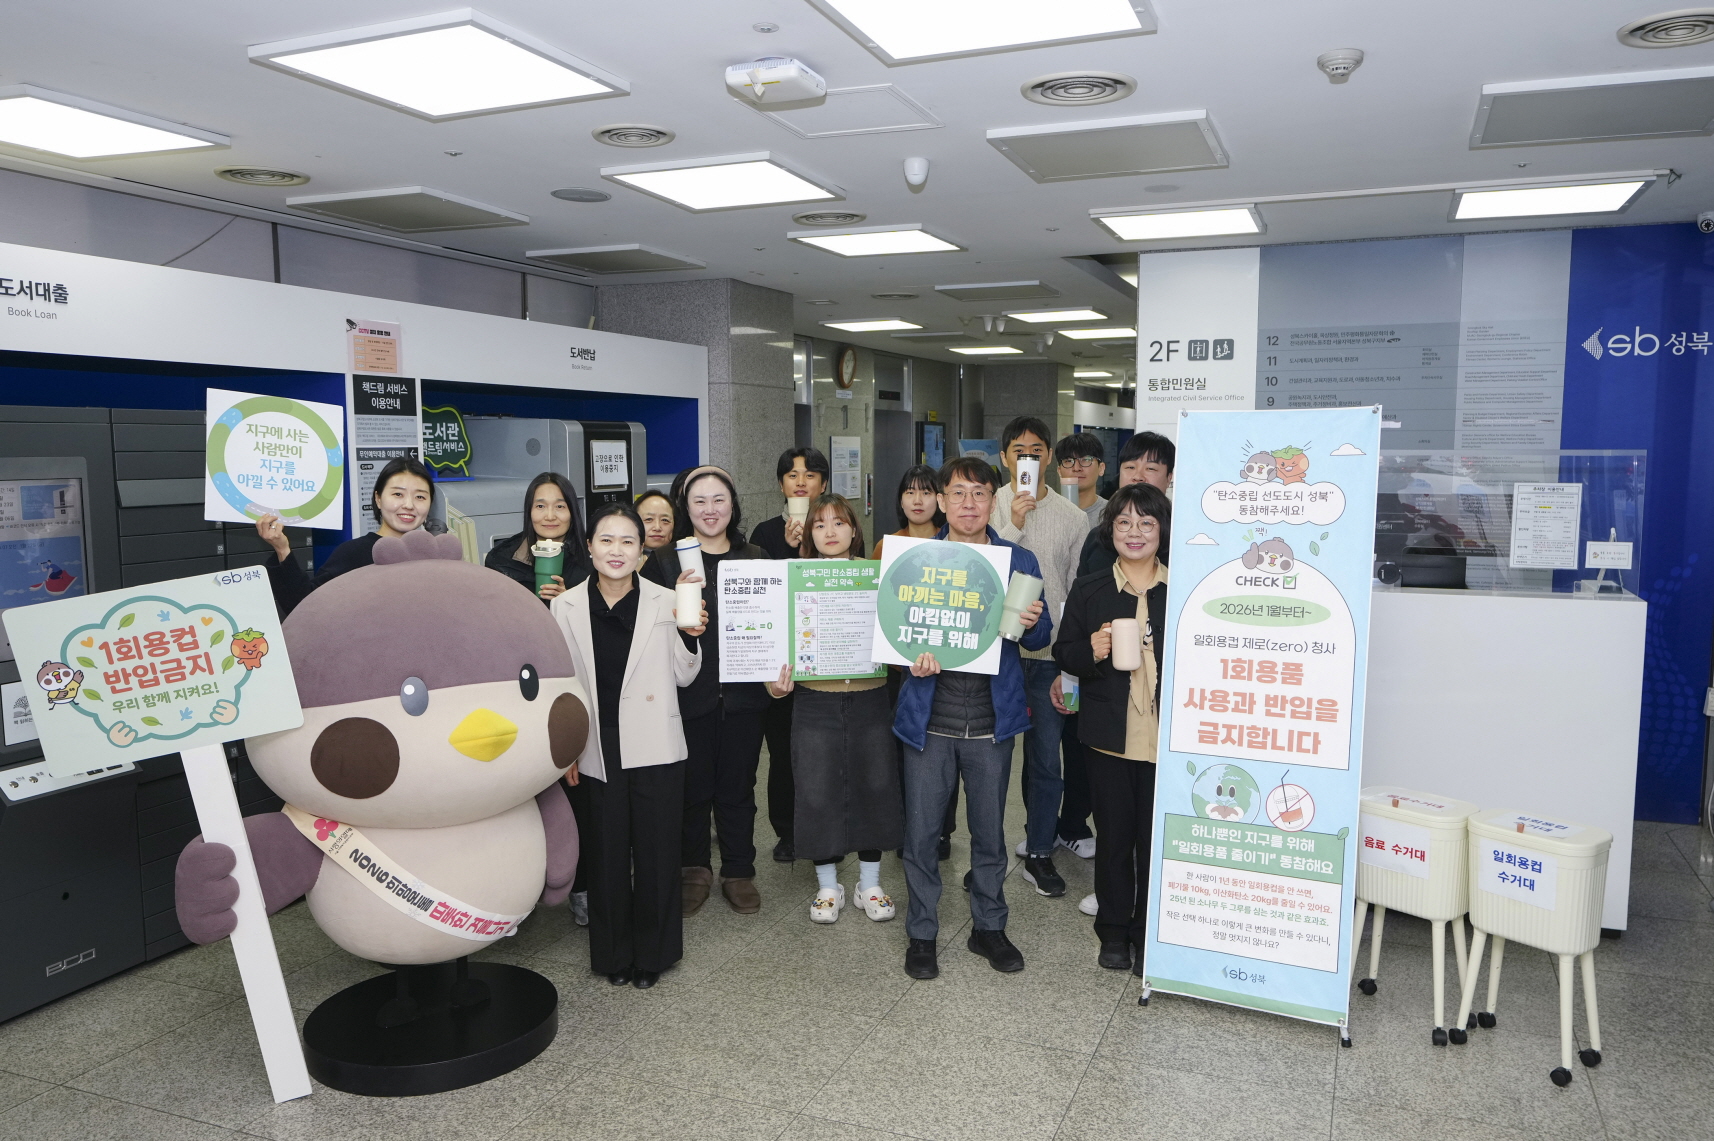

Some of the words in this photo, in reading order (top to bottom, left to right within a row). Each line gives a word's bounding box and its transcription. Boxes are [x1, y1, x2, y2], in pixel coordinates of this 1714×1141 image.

[0, 278, 69, 304] 도서대출
[7, 307, 32, 317] Book
[35, 309, 57, 320] Loan
[1266, 336, 1279, 346] 12
[1608, 326, 1660, 356] sb
[1664, 332, 1713, 356] 성북
[570, 347, 596, 361] 도서반납
[1150, 340, 1180, 362] 2F
[1267, 356, 1277, 366] 11
[362, 382, 385, 394] 책드림
[386, 383, 408, 394] 서비스
[1148, 378, 1206, 392] 통합민원실
[1265, 376, 1278, 386] 10
[371, 397, 401, 409] 이용안내
[1266, 397, 1275, 406] 9
[246, 424, 283, 440] 지구에
[286, 429, 309, 443] 사는
[422, 422, 459, 440] 도서관
[253, 441, 302, 458] 사람만이
[595, 454, 612, 463] 고장으로
[614, 454, 624, 463] 인한
[260, 459, 296, 476] 지구를
[600, 465, 618, 473] 이용중지
[238, 474, 262, 490] 아낄
[266, 476, 278, 490] 수
[282, 478, 316, 492] 있어요
[1213, 490, 1258, 501] "탄소중립
[1262, 490, 1303, 501] 선도도시
[1308, 490, 1334, 503] 성북"
[1239, 505, 1304, 516] 동참해주세요!
[1255, 527, 1267, 536] 짹!
[222, 572, 242, 584] sb
[243, 570, 261, 580] 성북
[802, 568, 830, 577] 성북구민
[832, 568, 859, 577] 탄소중립
[861, 568, 875, 576] 생활
[920, 566, 968, 588] 지구를
[724, 578, 752, 586] 성북구와
[753, 578, 768, 586] 함께
[770, 578, 782, 586] 하는
[724, 587, 751, 595] 탄소중립
[753, 586, 766, 594] 실천
[824, 578, 838, 587] 실천
[840, 578, 854, 586] 약속
[1236, 576, 1279, 588] CHECK
[898, 585, 945, 606] 아끼는
[948, 590, 985, 612] 마음,
[909, 606, 970, 629] 아낌없이
[1220, 603, 1264, 617] 2026년
[1266, 605, 1312, 618] 1월부터~
[98, 625, 201, 665] 1회용컵
[897, 625, 943, 647] 지구를
[948, 630, 979, 650] 위해
[1194, 634, 1239, 648] 일회용컵
[1242, 637, 1308, 653] 제로(zero)
[1311, 642, 1336, 654] 청사
[103, 652, 215, 694] 반입금지
[1220, 658, 1304, 685] 1회용품
[112, 697, 140, 713] 우리
[142, 691, 172, 708] 함께
[174, 681, 220, 701] 지켜요!
[1183, 688, 1256, 714] 사용과
[1264, 694, 1339, 723] 반입을
[1197, 721, 1321, 755] 금지합니다
[1192, 824, 1241, 844] 하나뿐인
[1245, 830, 1283, 848] 지구를
[1287, 838, 1315, 853] 위해
[1172, 840, 1227, 860] "일회용품
[1231, 847, 1276, 865] 줄이기"
[1280, 855, 1333, 875] 동참해요
[1364, 836, 1386, 851] 음료
[1391, 843, 1426, 863] 수거대
[1492, 849, 1542, 874] 일회용컵
[1187, 872, 1193, 880] 한
[1196, 874, 1217, 883] 사람이
[1219, 877, 1230, 885] 1년
[1232, 878, 1246, 888] 동안
[1248, 880, 1285, 894] 일회용컵을
[1287, 887, 1294, 895] 안
[1296, 889, 1314, 899] 쓰면,
[1498, 870, 1535, 892] 수거대
[1168, 881, 1189, 892] 폐기물
[1191, 886, 1211, 896] 10kg,
[1213, 889, 1249, 901] 이산화탄소
[1251, 894, 1279, 906] 20kg를
[1281, 899, 1296, 908] 줄일
[1308, 903, 1333, 914] 있어요.
[429, 901, 472, 927] 따뜻한
[1170, 895, 1186, 904] 25년
[1189, 897, 1195, 905] 된
[1197, 899, 1218, 909] 소나무
[1220, 902, 1228, 910] 두
[1229, 904, 1251, 914] 그루를
[1253, 907, 1268, 917] 심는
[1270, 910, 1285, 919] 것과
[1287, 913, 1302, 922] 같은
[1304, 916, 1329, 926] 효과죠.
[1166, 910, 1180, 920] 작은
[1182, 913, 1196, 922] 선택
[1198, 916, 1219, 926] 하나로
[1222, 920, 1243, 930] 이렇게
[1245, 923, 1252, 932] 큰
[1255, 925, 1276, 936] 변화를
[1279, 929, 1294, 939] 만들
[1306, 934, 1330, 946] 있다니,
[1212, 931, 1227, 940] 정말
[1229, 934, 1251, 945] 멋지지
[1253, 938, 1279, 949] 않나요?
[1229, 968, 1248, 981] sb
[1249, 973, 1266, 984] 성북
